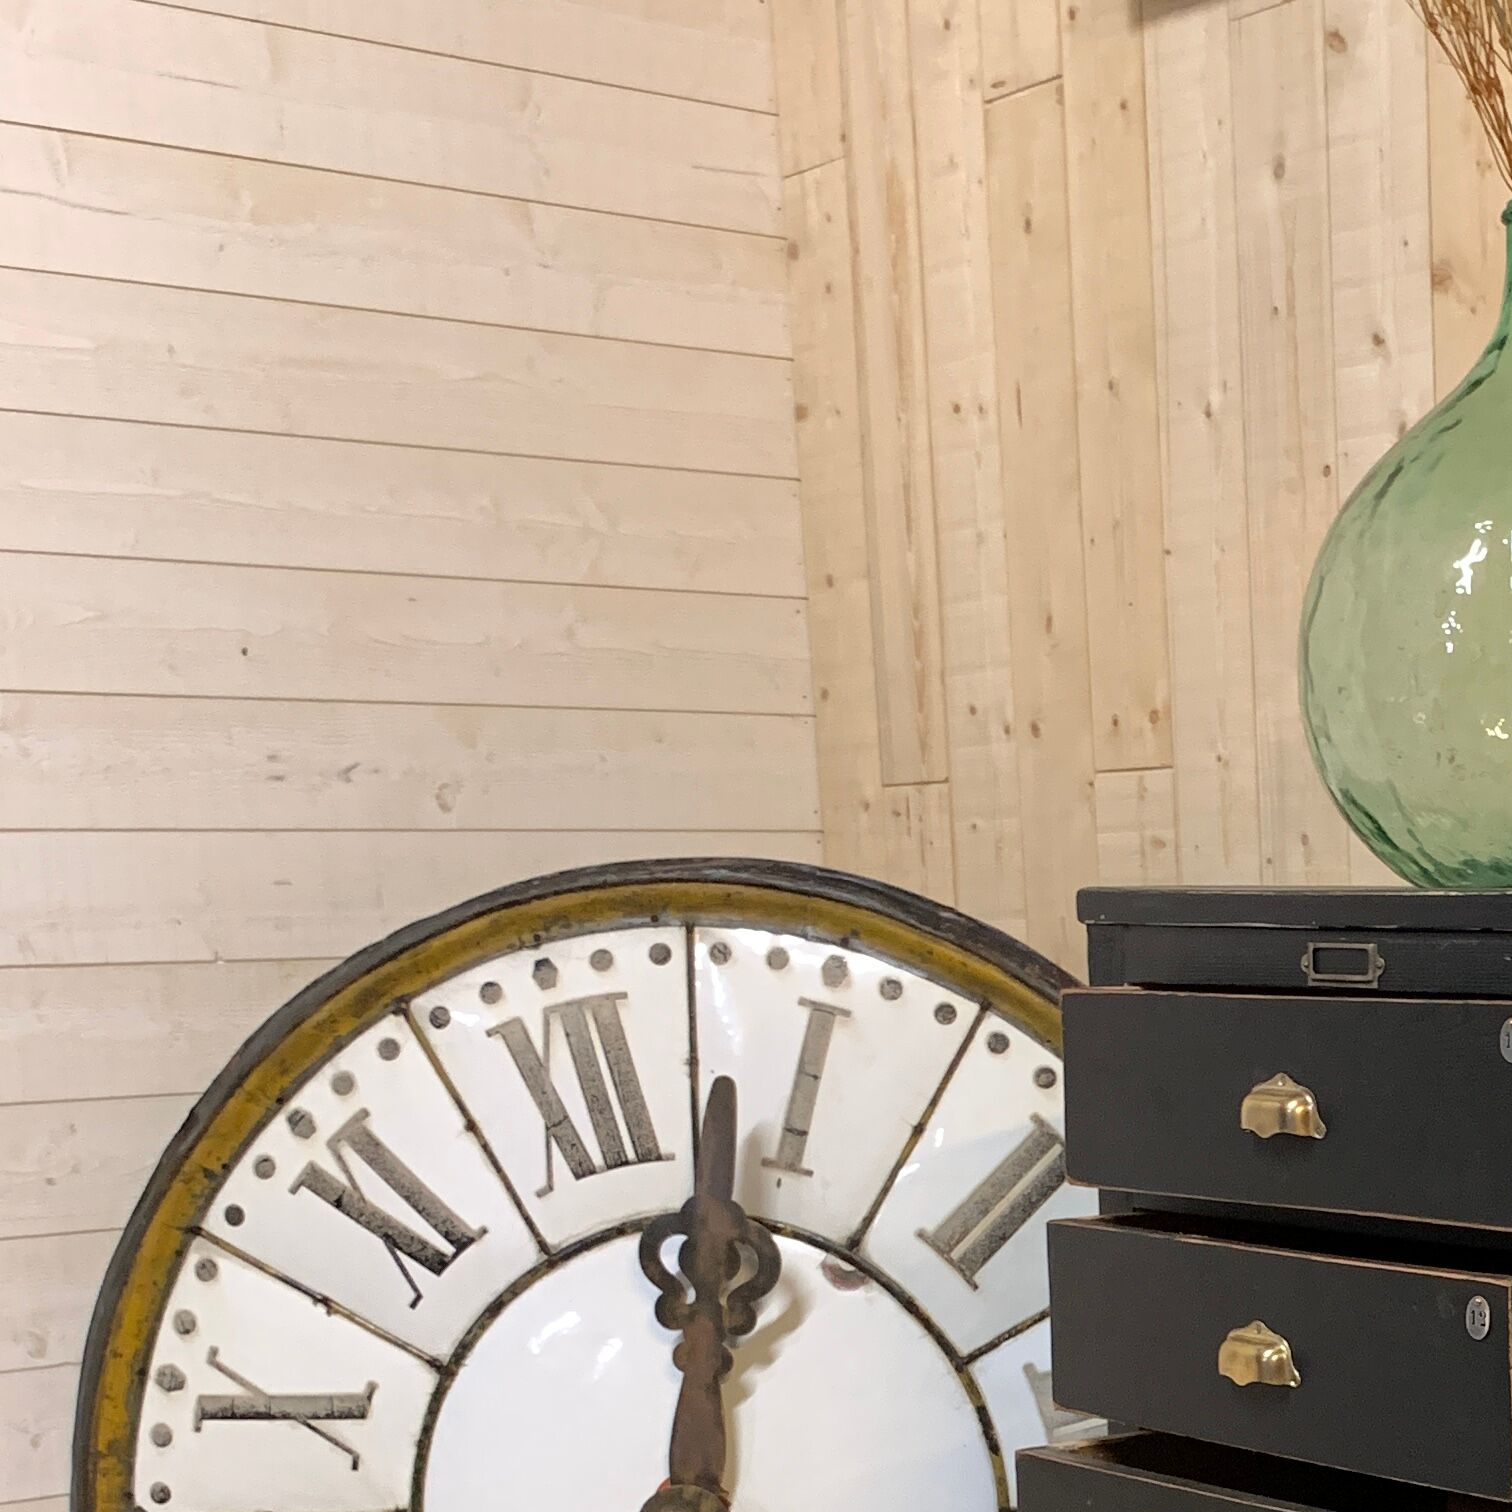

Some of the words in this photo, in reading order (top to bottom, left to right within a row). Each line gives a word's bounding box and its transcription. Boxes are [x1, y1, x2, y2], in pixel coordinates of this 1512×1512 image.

[486, 991, 675, 1197] XII
[762, 997, 851, 1176] I
[290, 1108, 487, 1309] XI
[193, 1345, 379, 1471] X
[1470, 1311, 1486, 1326] 12
